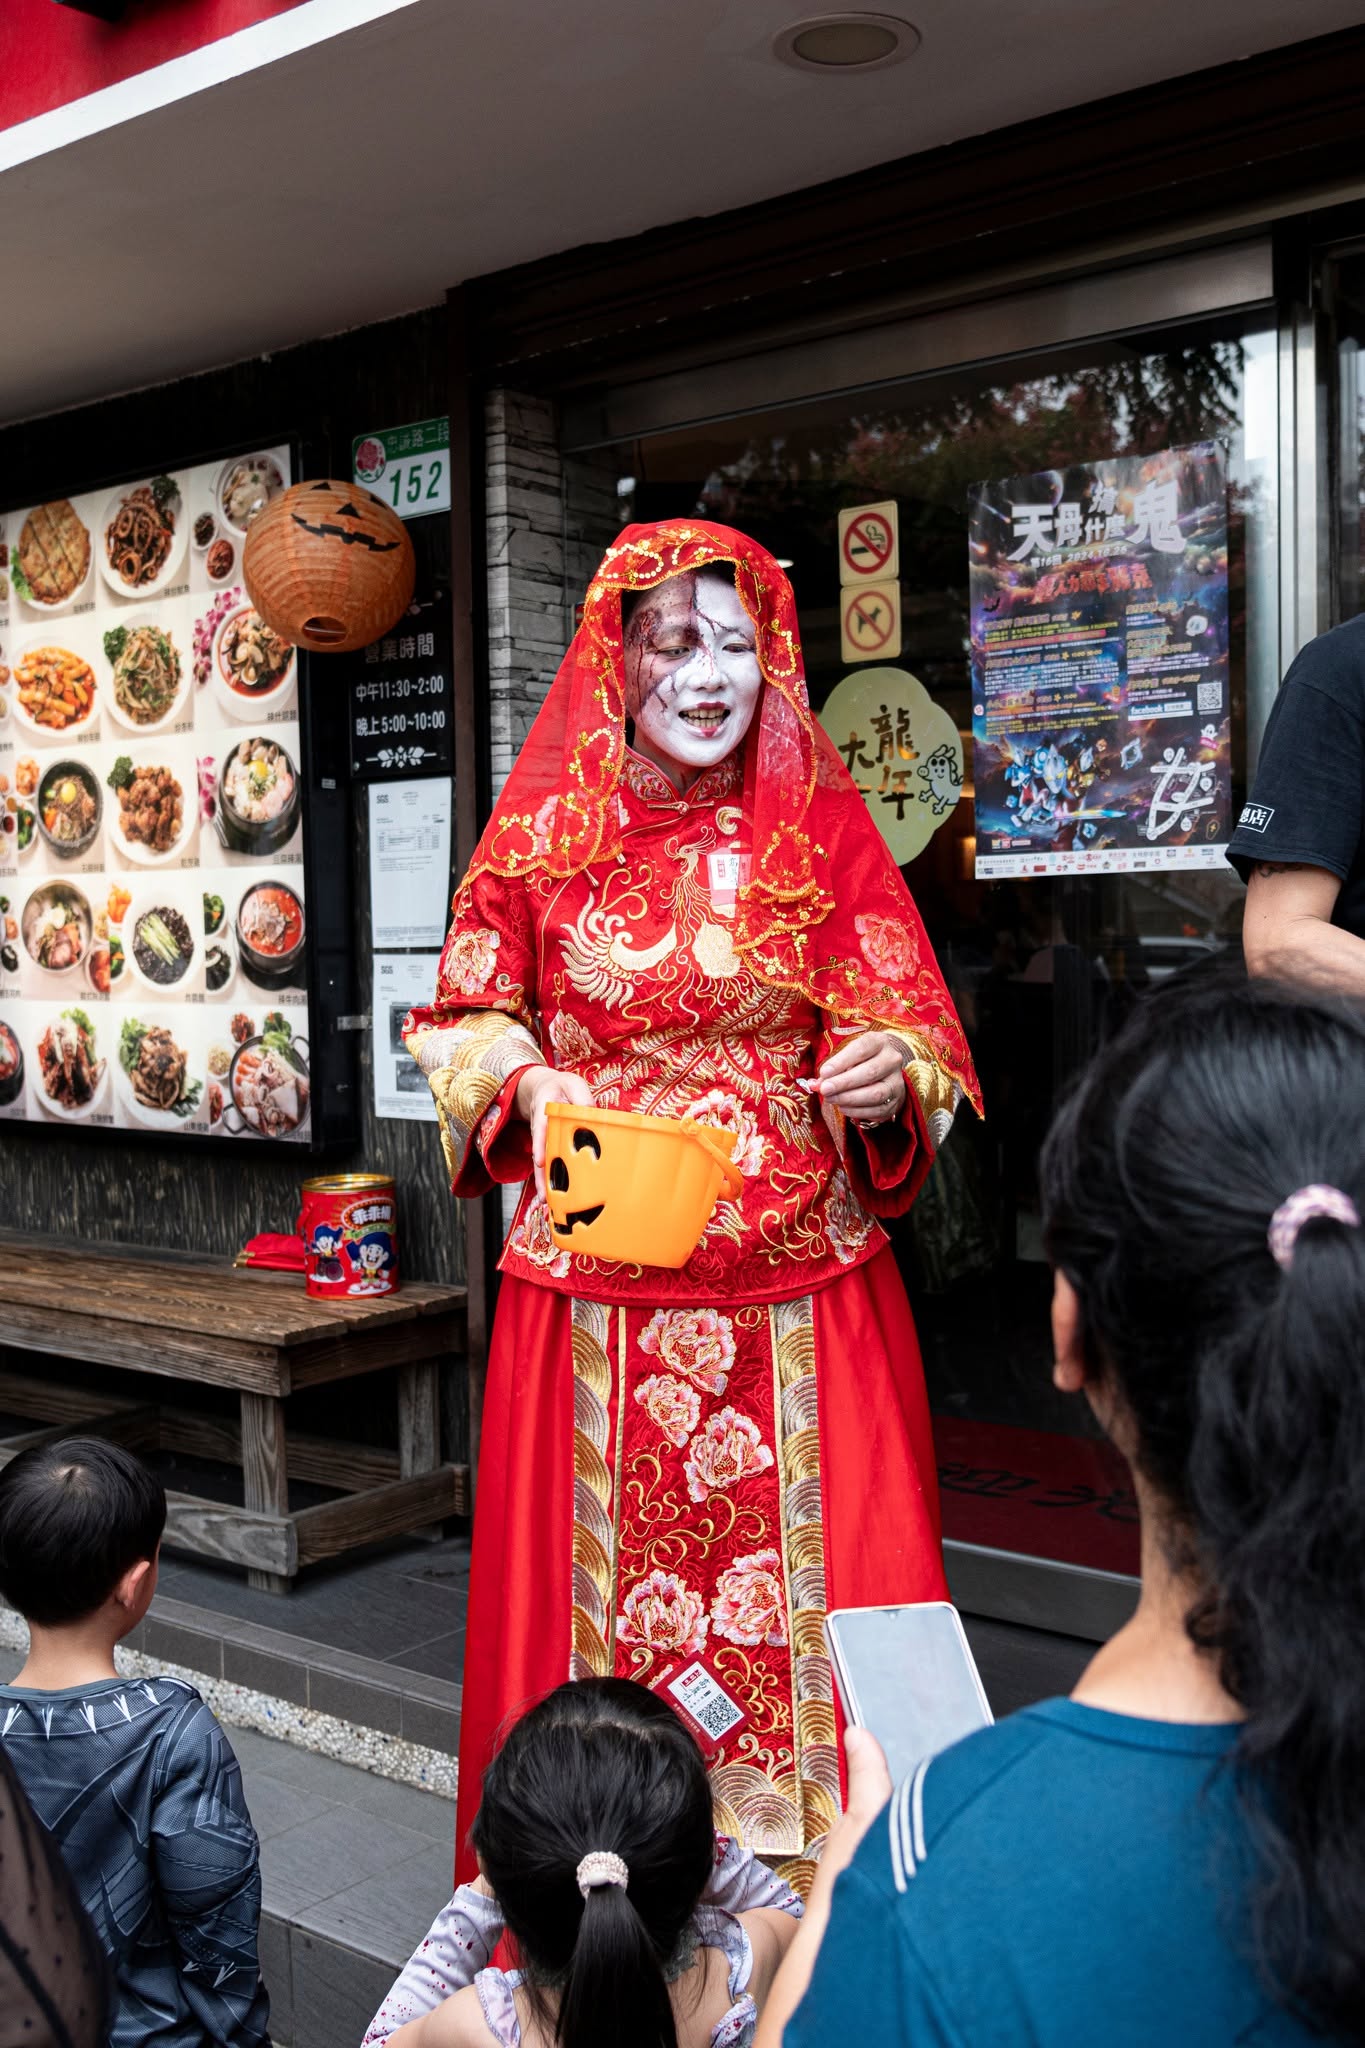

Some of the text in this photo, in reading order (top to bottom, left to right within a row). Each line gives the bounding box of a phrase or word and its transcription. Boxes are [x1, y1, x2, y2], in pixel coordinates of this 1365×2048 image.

[389, 461, 442, 507] 152
[365, 632, 434, 664] 營業時間
[870, 704, 920, 820] 龍年
